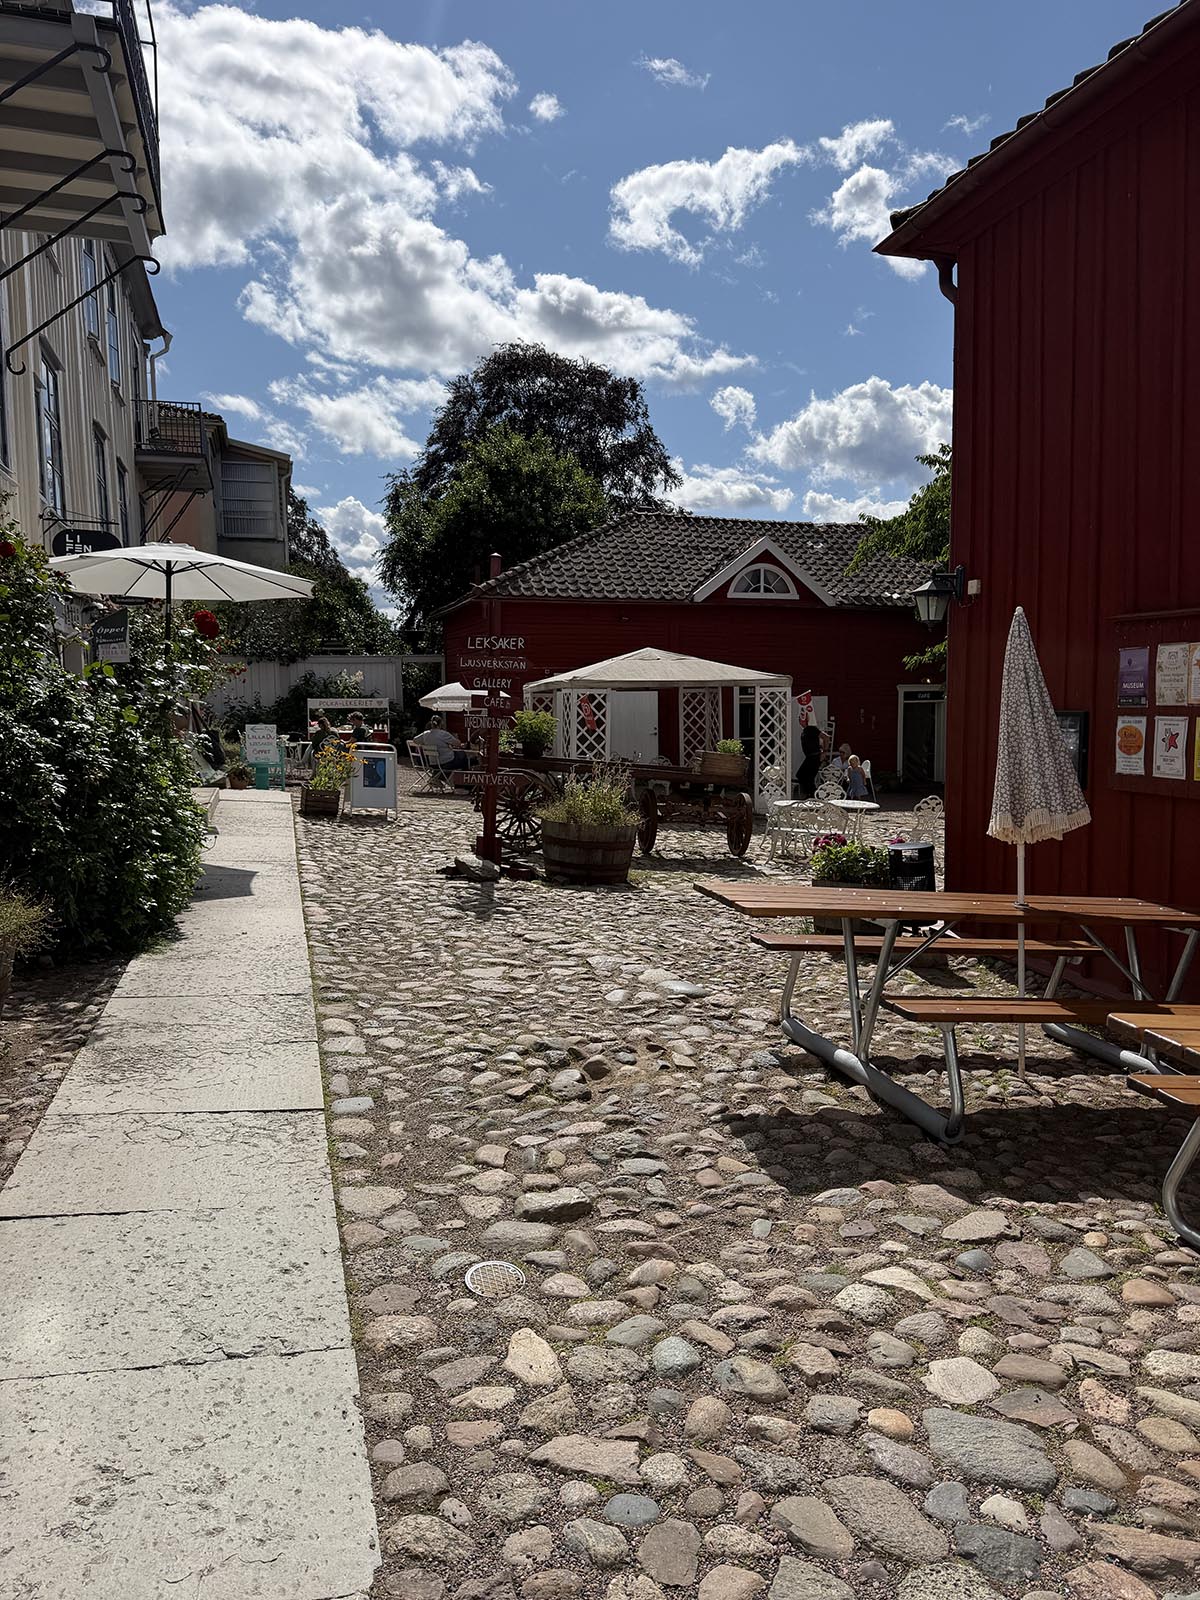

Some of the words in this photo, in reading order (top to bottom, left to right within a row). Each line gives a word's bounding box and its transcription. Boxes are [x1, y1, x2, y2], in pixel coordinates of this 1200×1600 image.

[467, 636, 525, 650] LEKSAKER
[459, 657, 527, 670] LJUSVERKSTAN
[473, 677, 512, 689] GALLERY
[463, 773, 516, 786] HANTVERK
